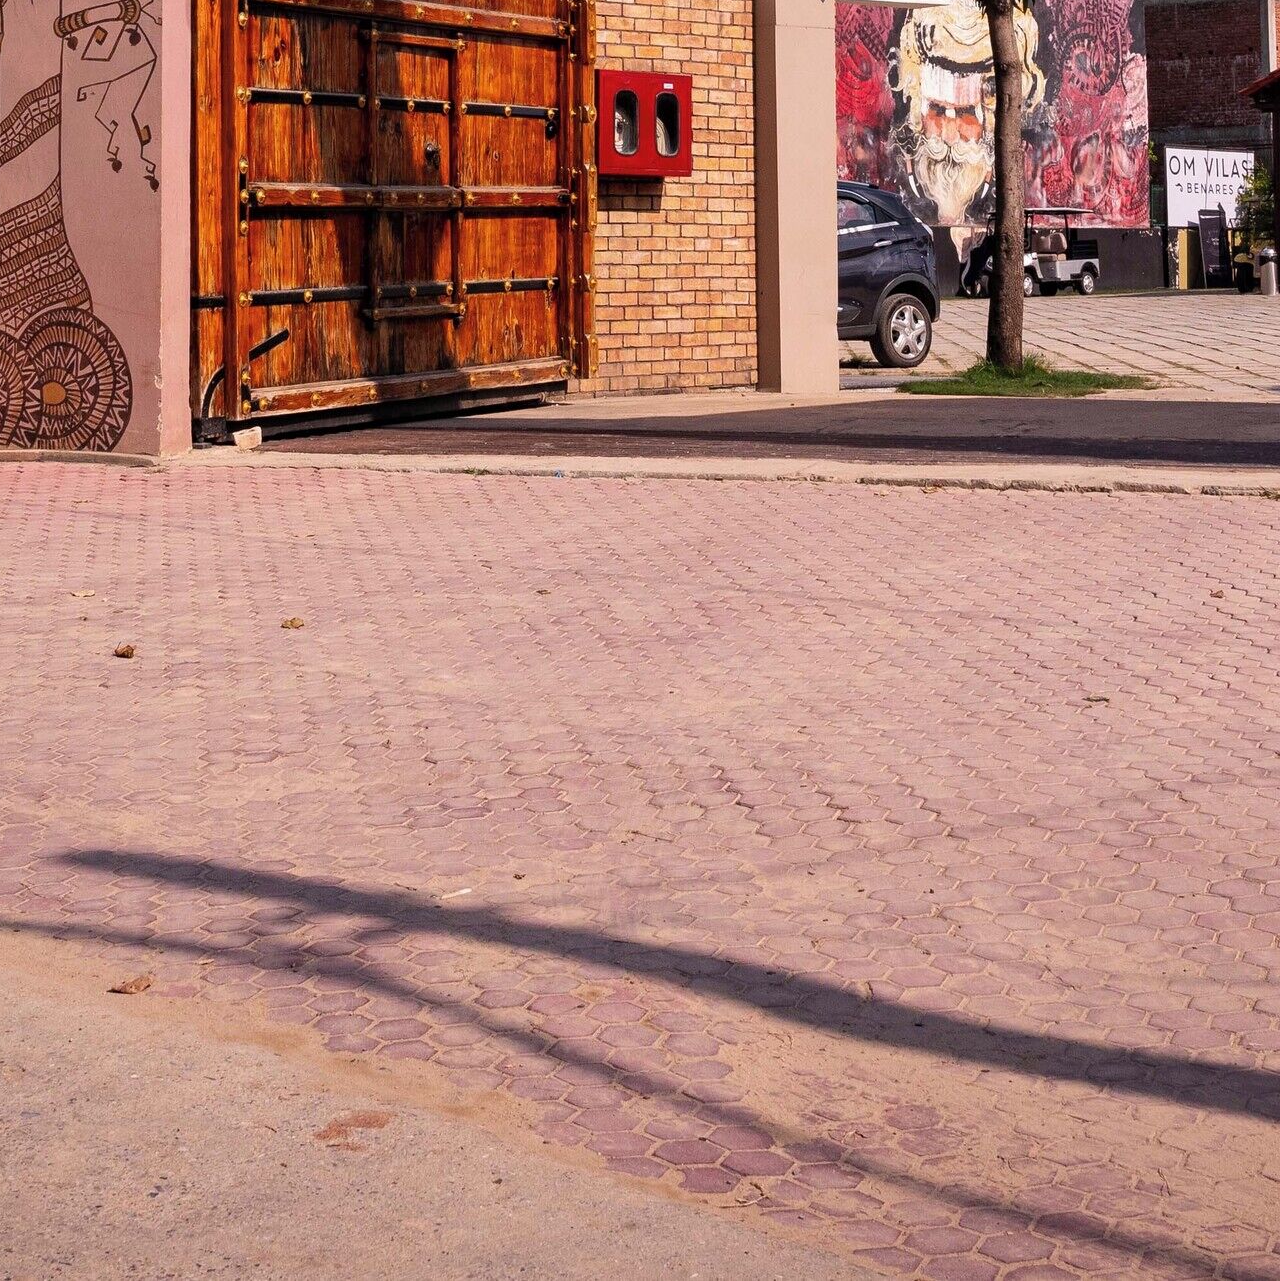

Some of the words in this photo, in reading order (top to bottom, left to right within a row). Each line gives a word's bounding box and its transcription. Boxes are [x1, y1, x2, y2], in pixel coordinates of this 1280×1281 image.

[1169, 155, 1196, 177] OM
[1204, 157, 1249, 179] VILAS
[1186, 182, 1234, 195] BENARES
